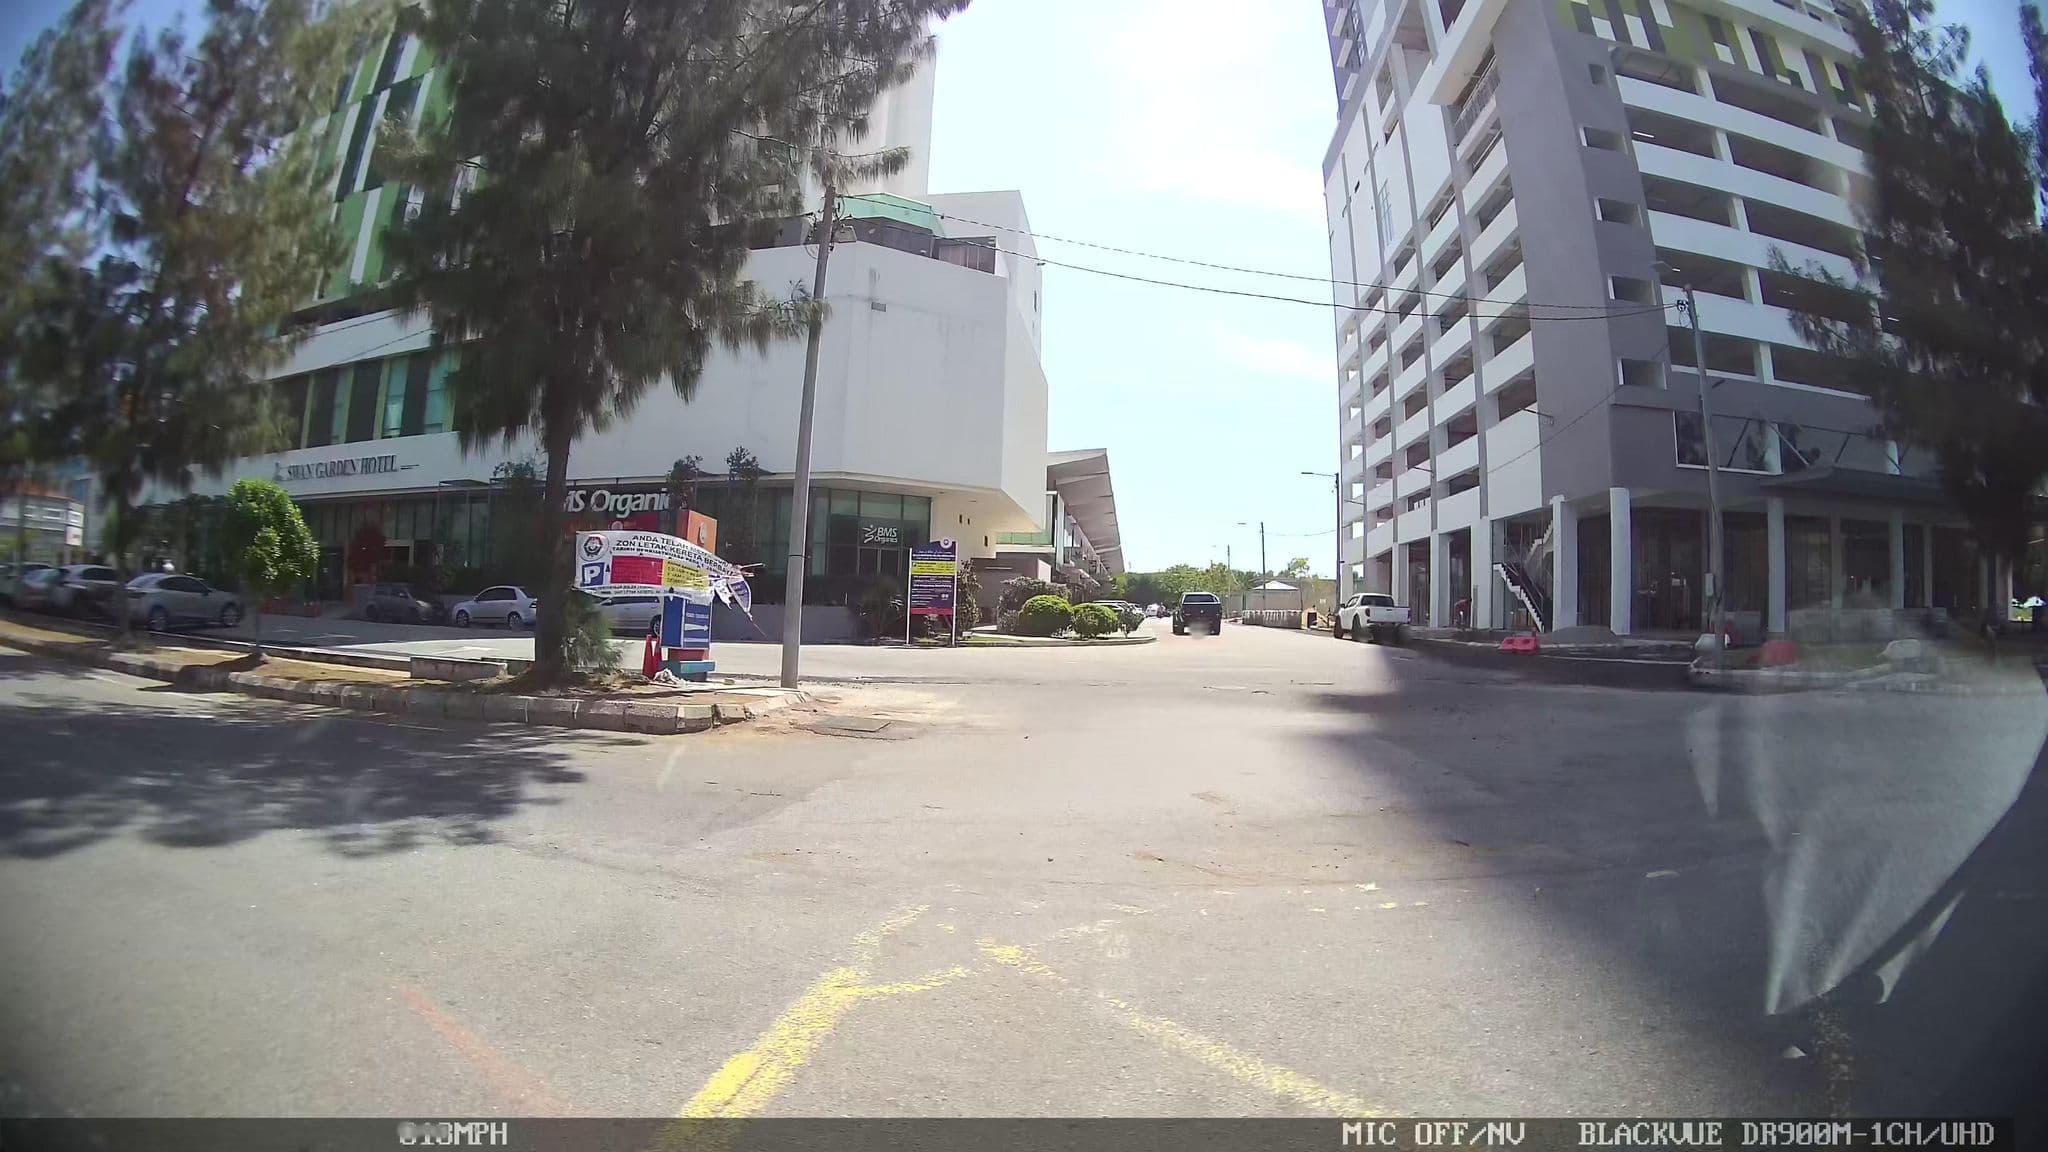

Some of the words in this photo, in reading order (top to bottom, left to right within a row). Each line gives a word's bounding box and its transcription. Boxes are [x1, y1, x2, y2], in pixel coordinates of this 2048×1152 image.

[286, 463, 315, 481] SWAN
[315, 458, 359, 479] GARDEN
[360, 454, 398, 475] HOTEL
[632, 534, 658, 543] ANDA
[877, 527, 898, 538] BMS
[616, 539, 636, 547] ZON
[638, 541, 667, 551] LETAK
[669, 546, 703, 561] KERETA
[584, 565, 601, 584] P
